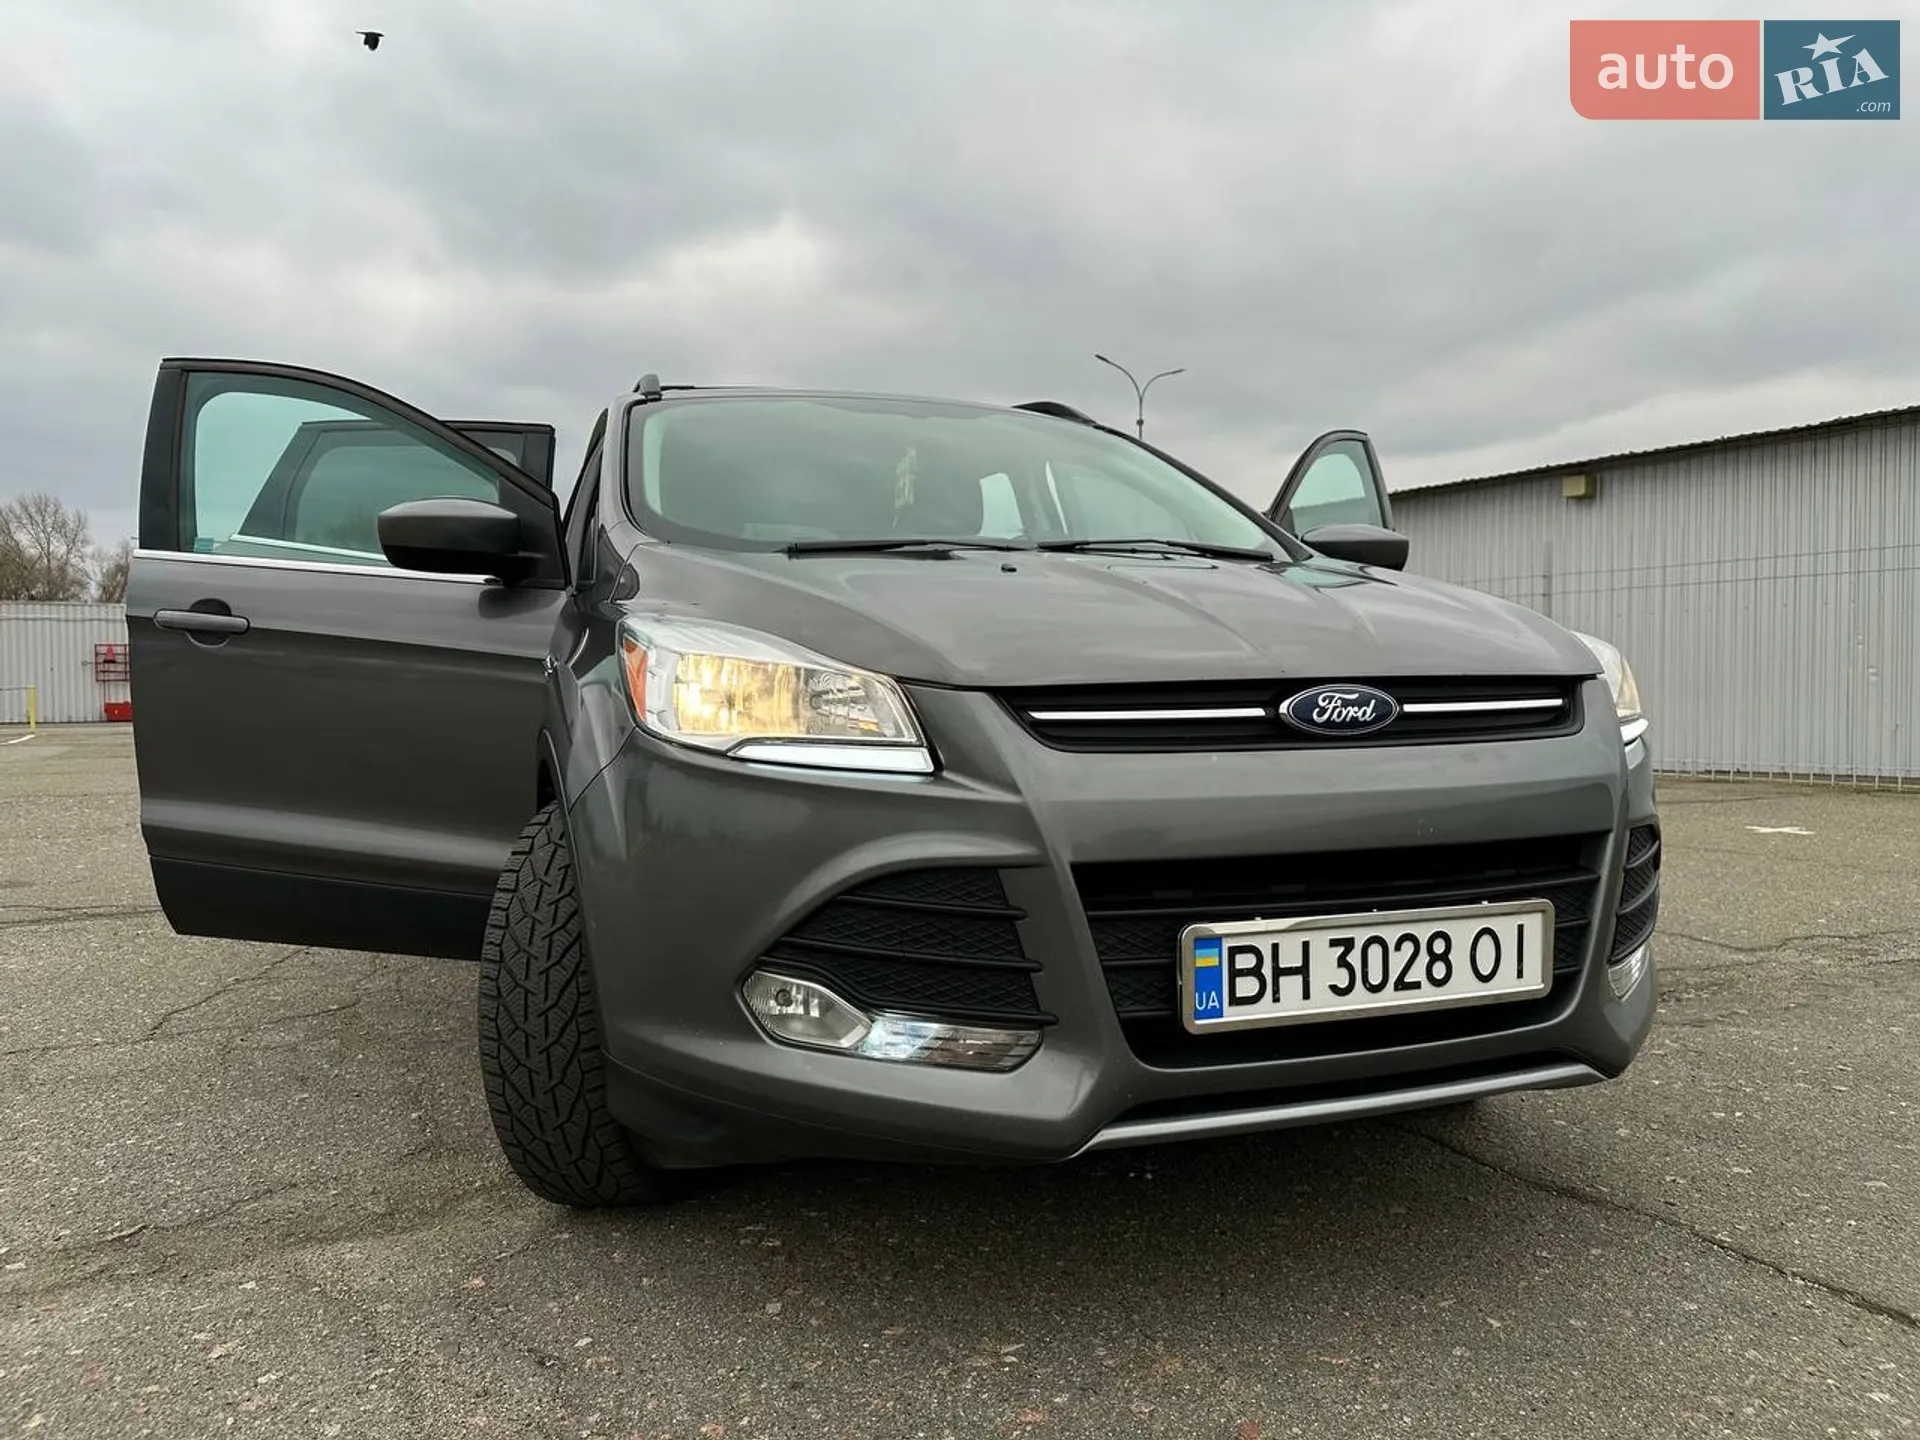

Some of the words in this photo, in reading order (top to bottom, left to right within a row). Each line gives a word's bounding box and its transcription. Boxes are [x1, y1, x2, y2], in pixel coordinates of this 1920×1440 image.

[1312, 692, 1376, 723] Ford
[1227, 940, 1310, 1007] BH
[1328, 930, 1453, 997] 3028
[1195, 990, 1220, 1011] UA
